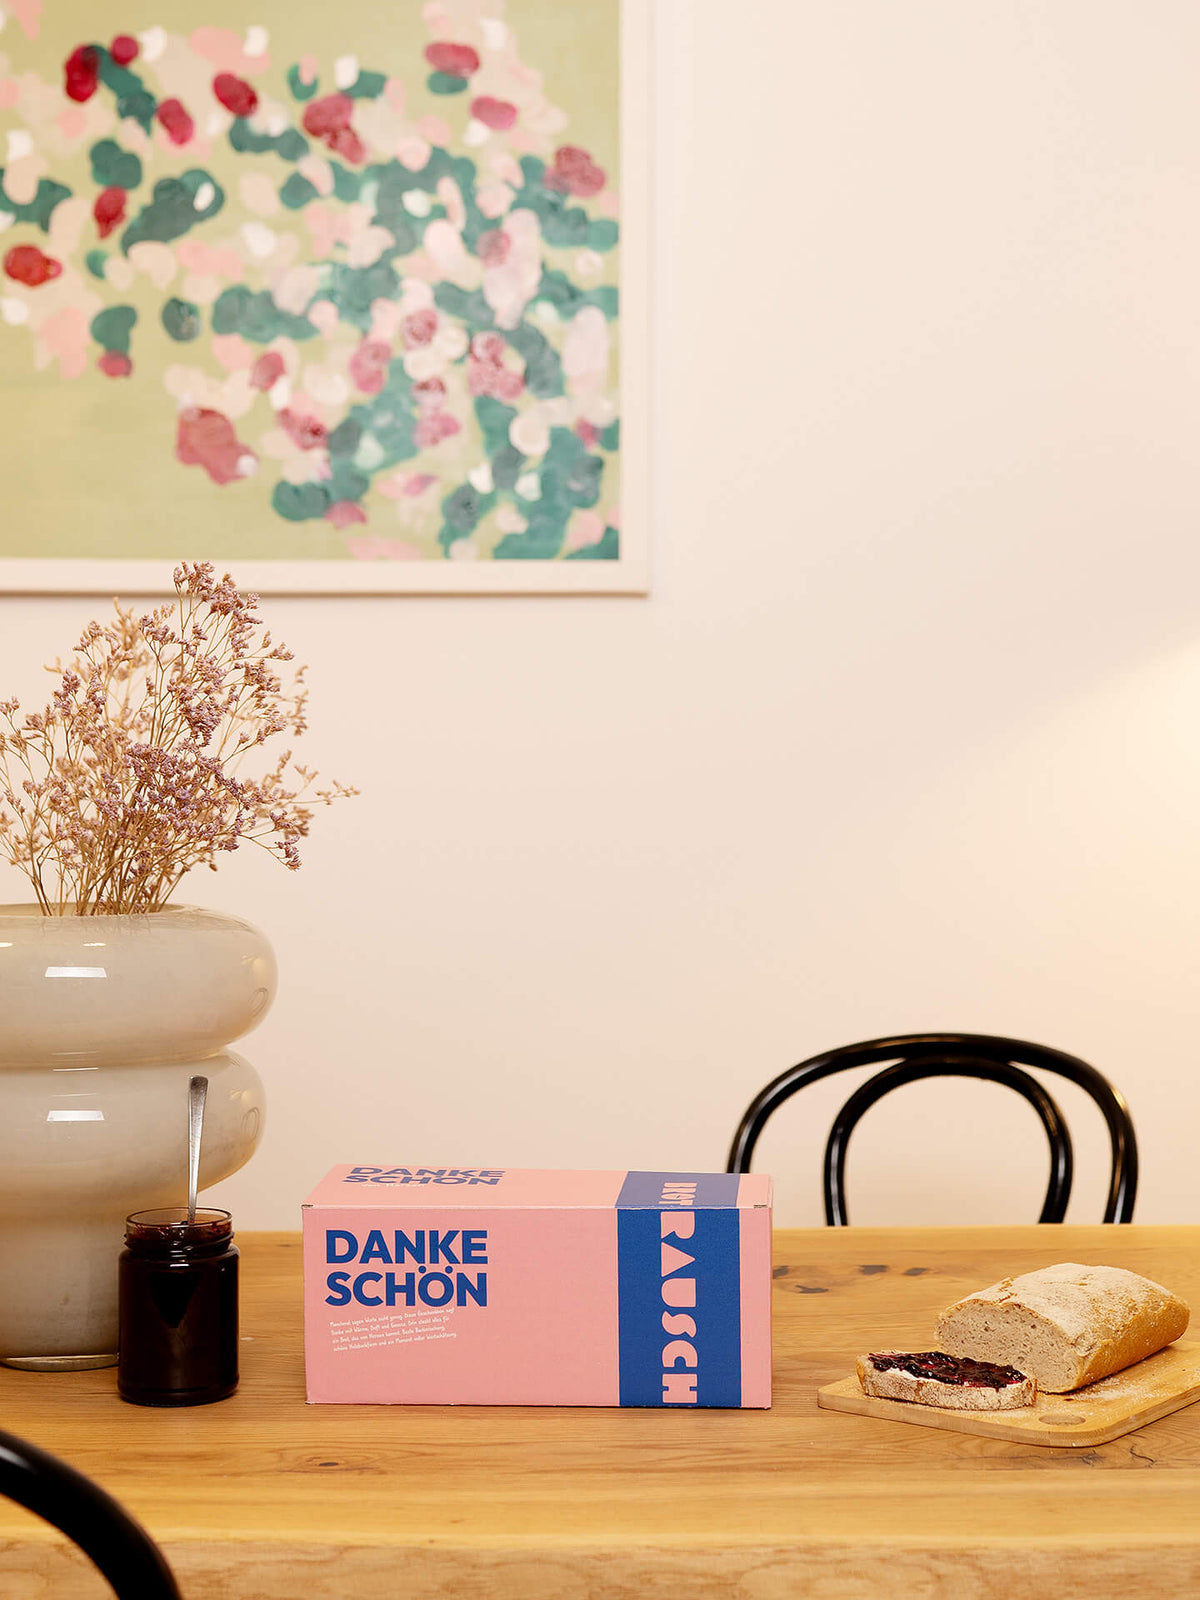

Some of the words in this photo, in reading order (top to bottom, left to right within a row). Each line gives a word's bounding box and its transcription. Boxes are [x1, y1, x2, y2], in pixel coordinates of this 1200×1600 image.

[350, 1167, 507, 1178] DANKE
[658, 1182, 698, 1206] BROT
[326, 1229, 488, 1265] DANKE
[324, 1265, 488, 1307] SCHÖN
[660, 1211, 698, 1404] RAUSCH
